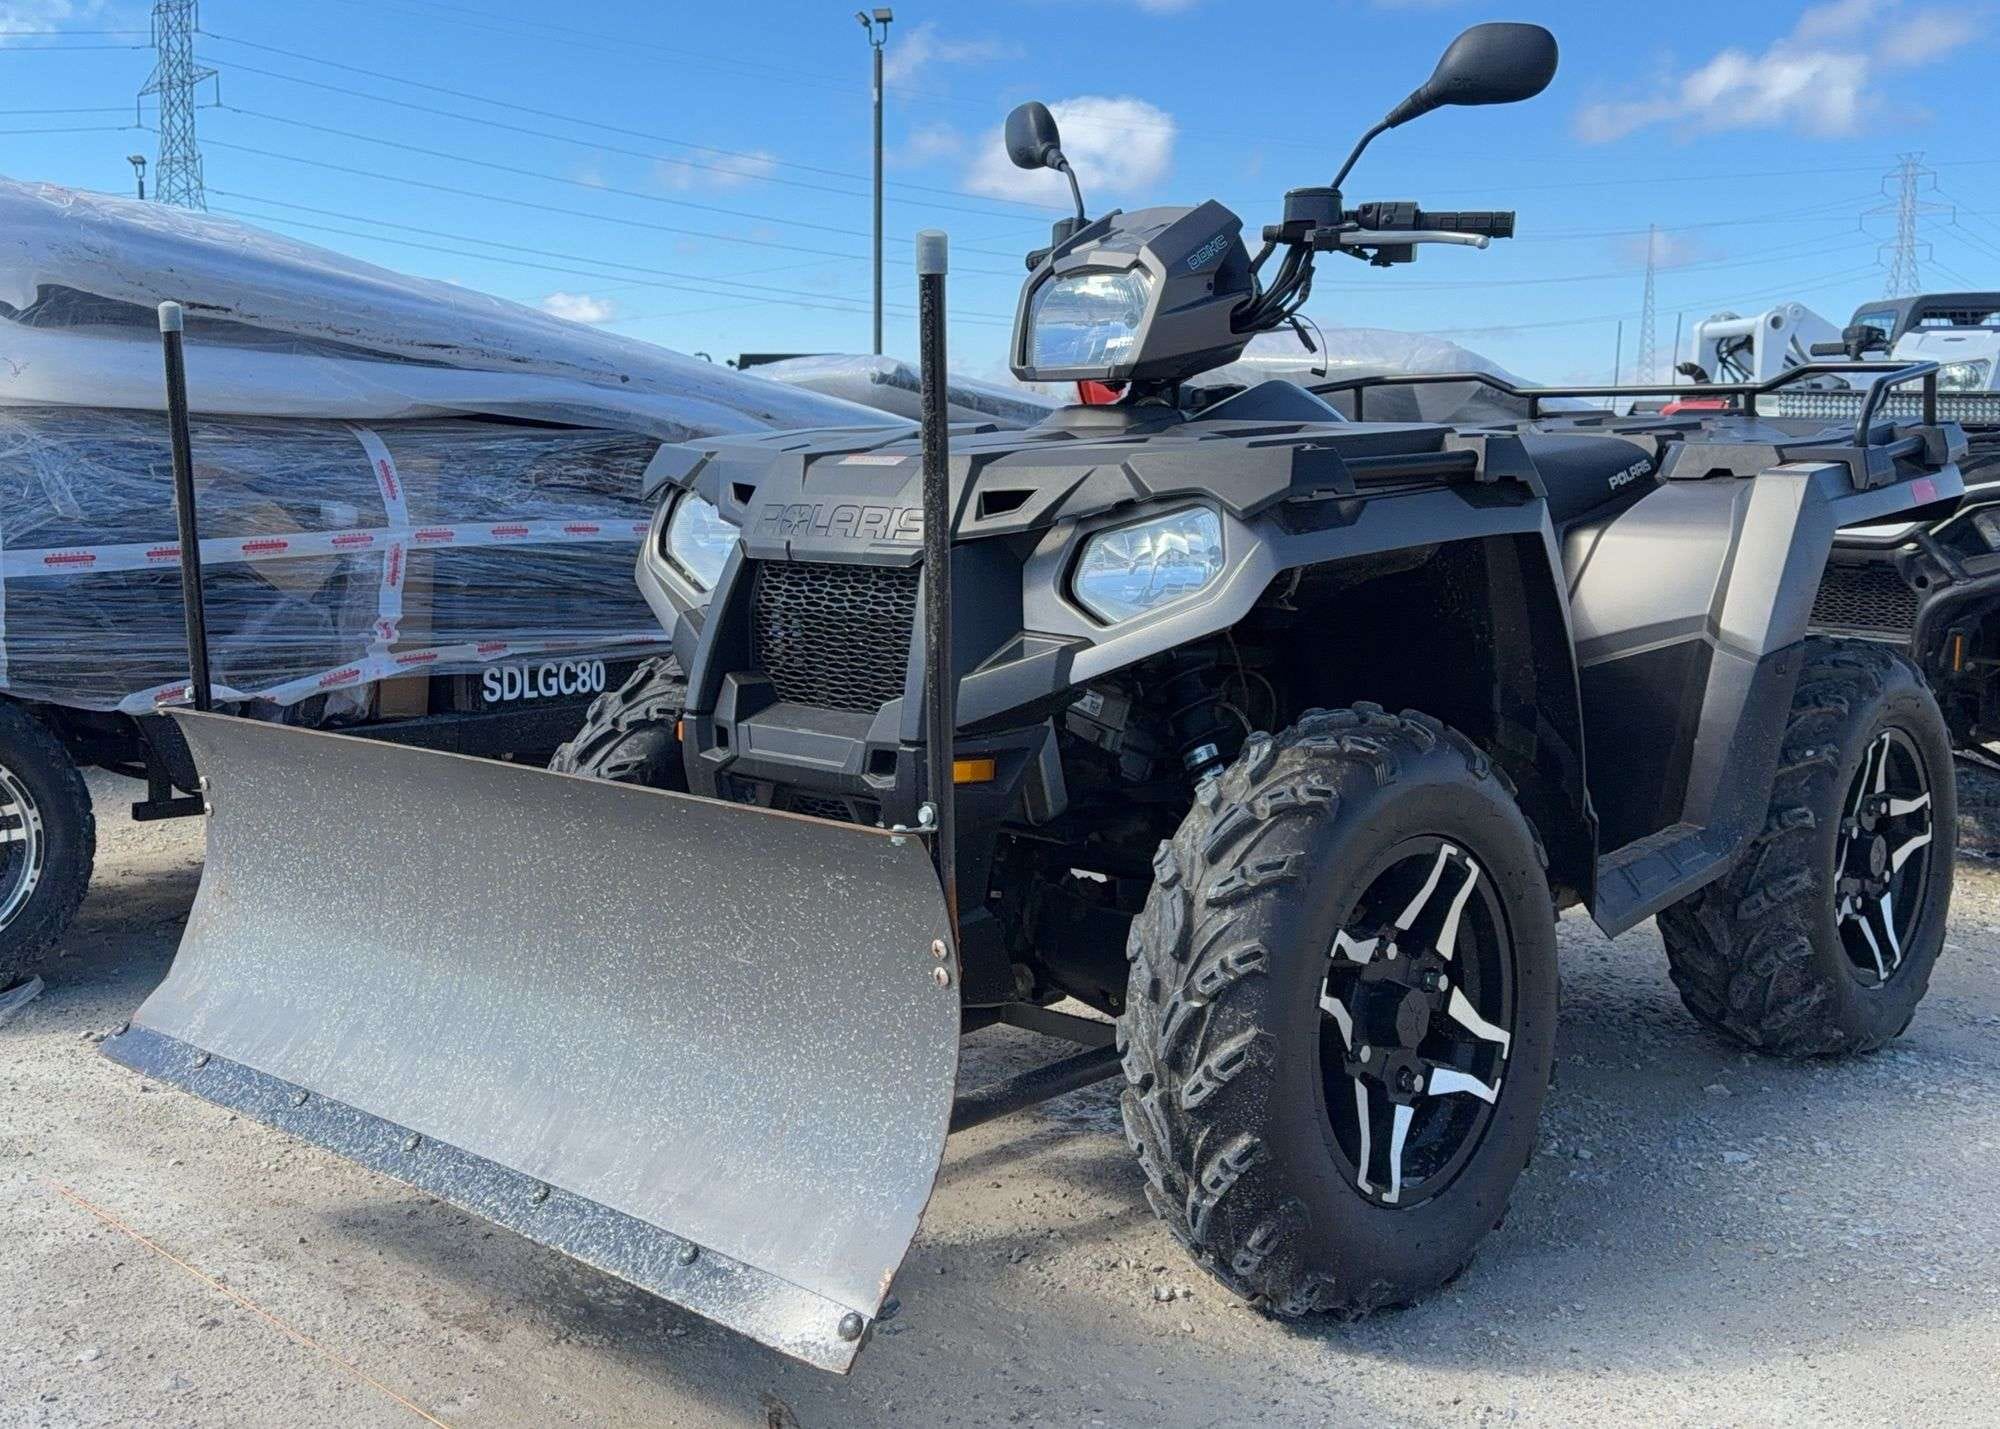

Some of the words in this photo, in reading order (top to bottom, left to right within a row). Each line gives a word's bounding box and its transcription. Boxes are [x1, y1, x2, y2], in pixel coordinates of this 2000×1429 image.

[1608, 459, 1652, 490] POLARIS
[755, 503, 924, 540] POLARIS
[482, 660, 606, 703] SDLGC80
